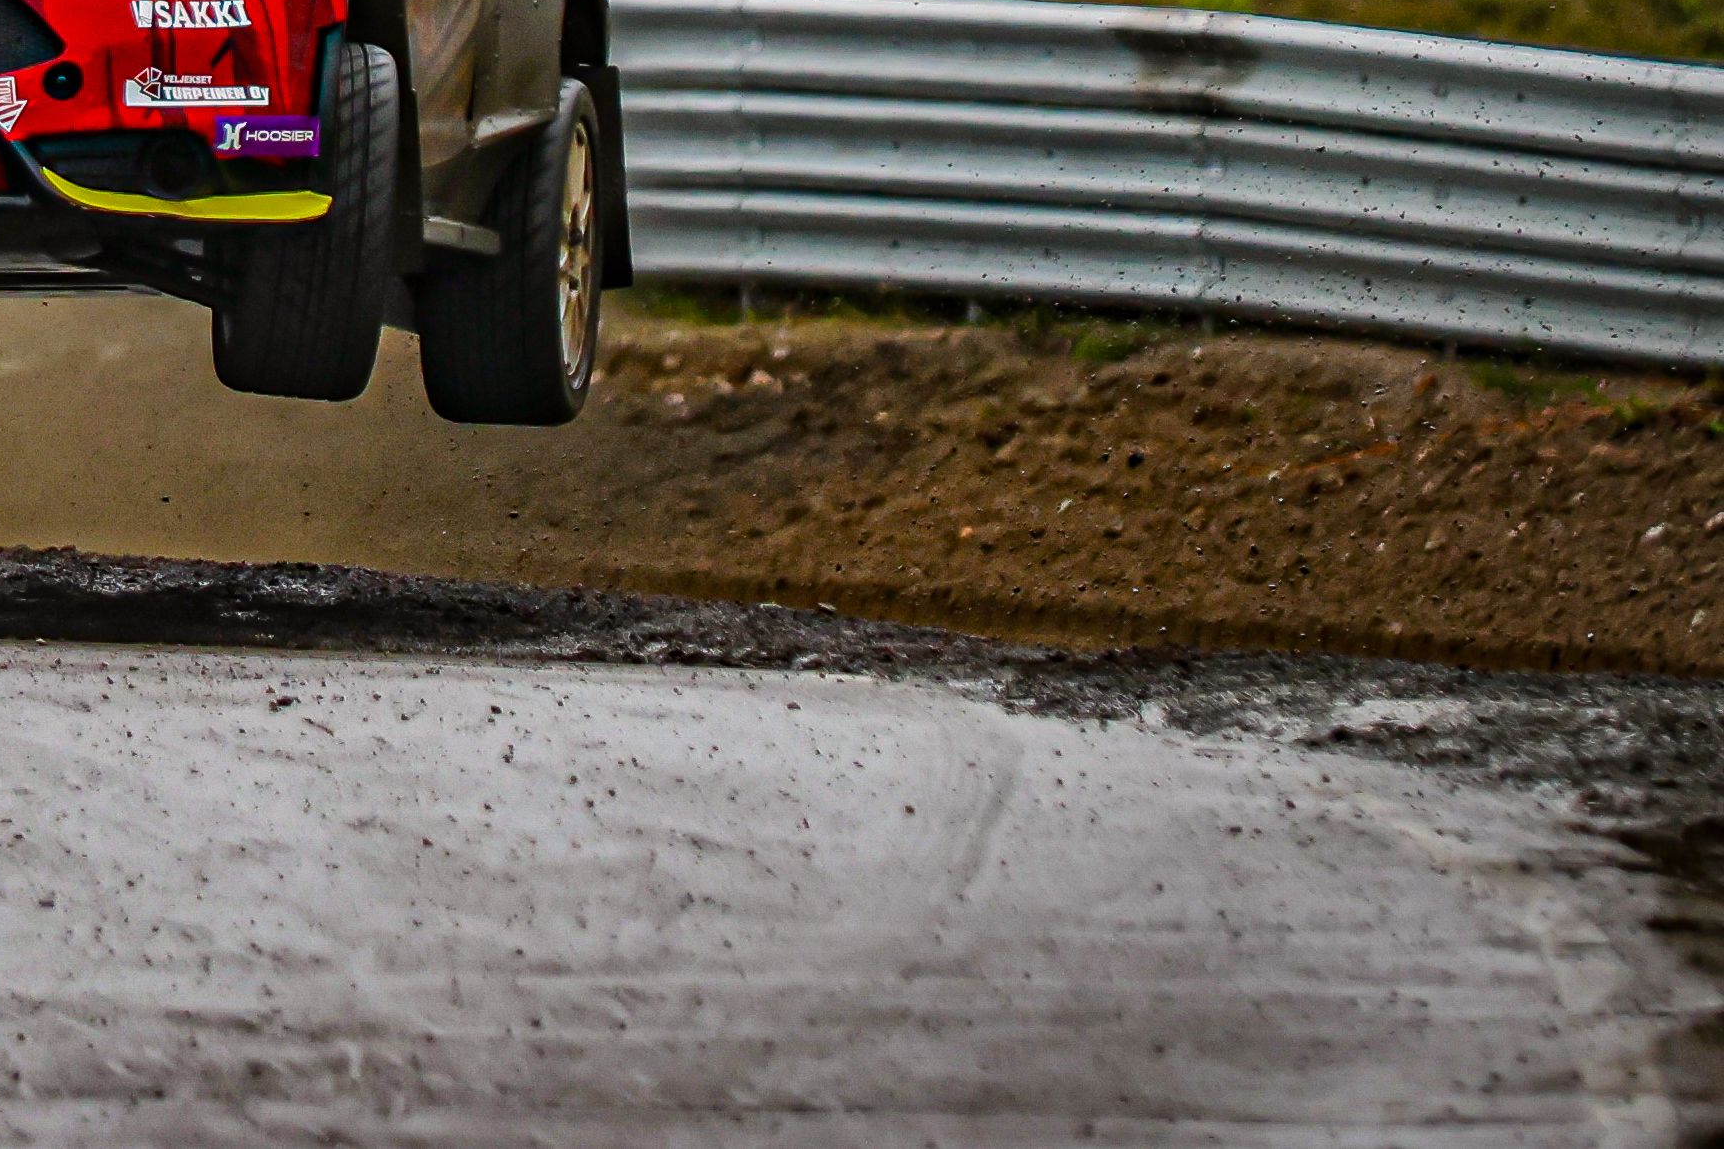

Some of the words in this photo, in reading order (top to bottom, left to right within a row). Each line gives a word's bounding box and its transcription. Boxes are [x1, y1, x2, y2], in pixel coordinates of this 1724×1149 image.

[154, 0, 252, 28] SAKKI
[163, 74, 213, 85] VELJEKSET
[162, 86, 247, 101] TURPEINEN
[249, 86, 270, 102] Oy
[245, 129, 314, 142] HOOSIER
